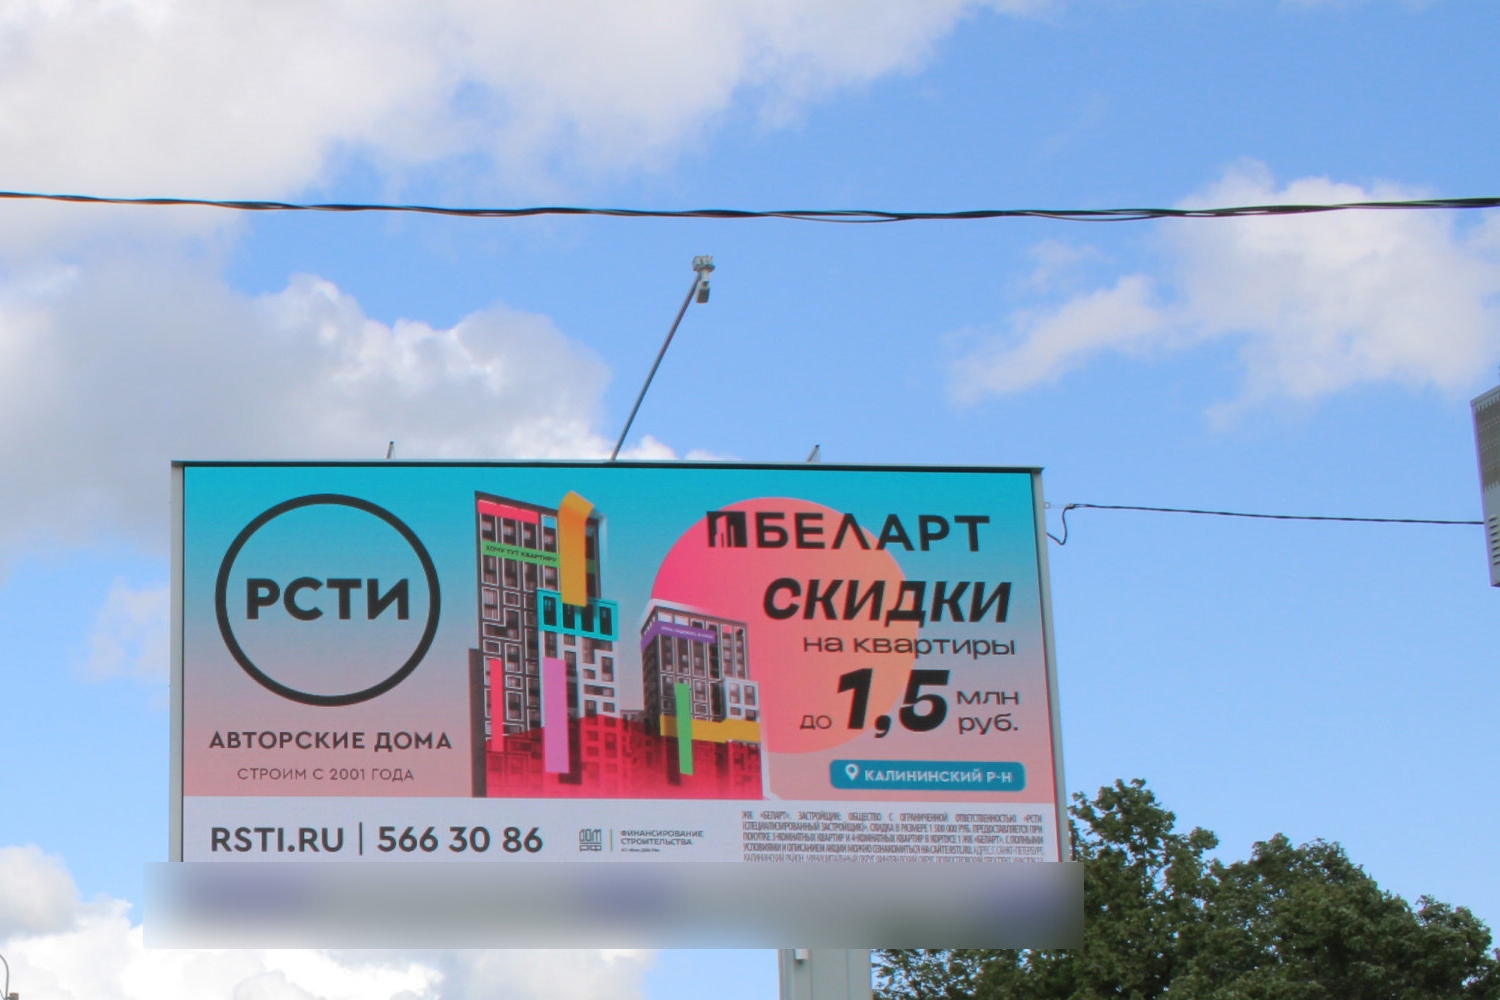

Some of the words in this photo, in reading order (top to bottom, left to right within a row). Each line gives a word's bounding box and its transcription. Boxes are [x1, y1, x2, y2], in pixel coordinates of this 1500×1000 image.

[755, 511, 990, 552] БЕЛАРТ
[246, 576, 409, 621] РСТИ
[763, 577, 1012, 628] СКИДКИ
[803, 636, 843, 653] на
[853, 637, 1015, 660] квартиры
[800, 714, 833, 730] до
[836, 667, 951, 739] 1,5
[956, 690, 1020, 705] млн
[957, 713, 1019, 735] руб.
[209, 731, 365, 750] АВТОРСКИЕ
[373, 732, 452, 753] ДОМА
[236, 767, 307, 781] СТРОИМ
[312, 768, 324, 781] С
[329, 768, 366, 781] 2001
[371, 768, 414, 783] ГОДА
[865, 768, 982, 783] КАЛИНИНСКИЙ
[986, 771, 1013, 783] Р-Н
[210, 826, 344, 854] RSTI.RU
[377, 826, 438, 854] 566
[448, 826, 491, 854] 30
[502, 826, 543, 855] 86
[620, 829, 704, 838] ФИНАНСИРОВАНИЕ
[620, 838, 693, 846] СТРОИТЕЛЬСТВА
